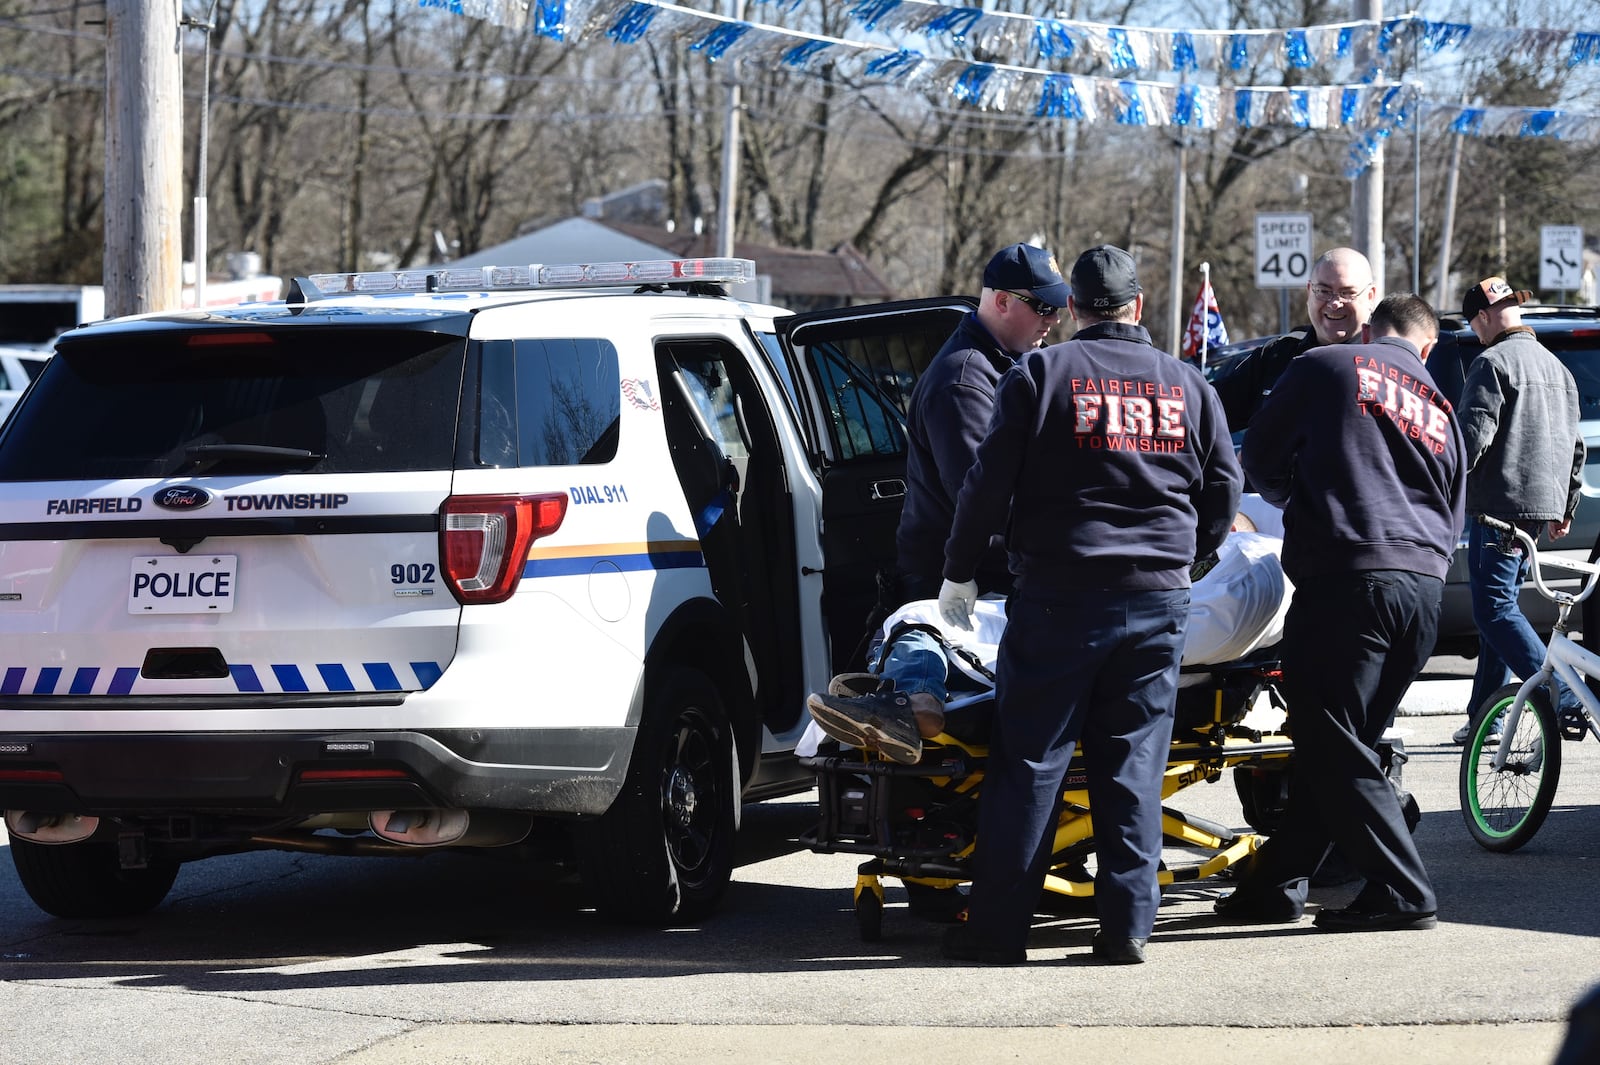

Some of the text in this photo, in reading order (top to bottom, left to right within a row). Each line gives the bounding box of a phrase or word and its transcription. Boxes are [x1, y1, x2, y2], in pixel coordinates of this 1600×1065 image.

[1261, 222, 1307, 235] SPEED
[1265, 237, 1301, 249] LIMIT
[1261, 252, 1307, 278] 40
[1093, 297, 1110, 307] 226
[1071, 378, 1183, 398] FAIRFIELD
[1354, 356, 1452, 414] FAIRFIELD
[1073, 394, 1185, 437] FIRE
[1356, 367, 1449, 444] FIRE
[1074, 436, 1185, 453] TOWNSHIP
[163, 489, 197, 505] Ford
[224, 494, 349, 511] TOWNSHIP
[569, 484, 628, 504] DIAL 911
[46, 497, 142, 515] FAIRFIELD
[391, 563, 435, 584] 902
[133, 572, 231, 598] POLICE
